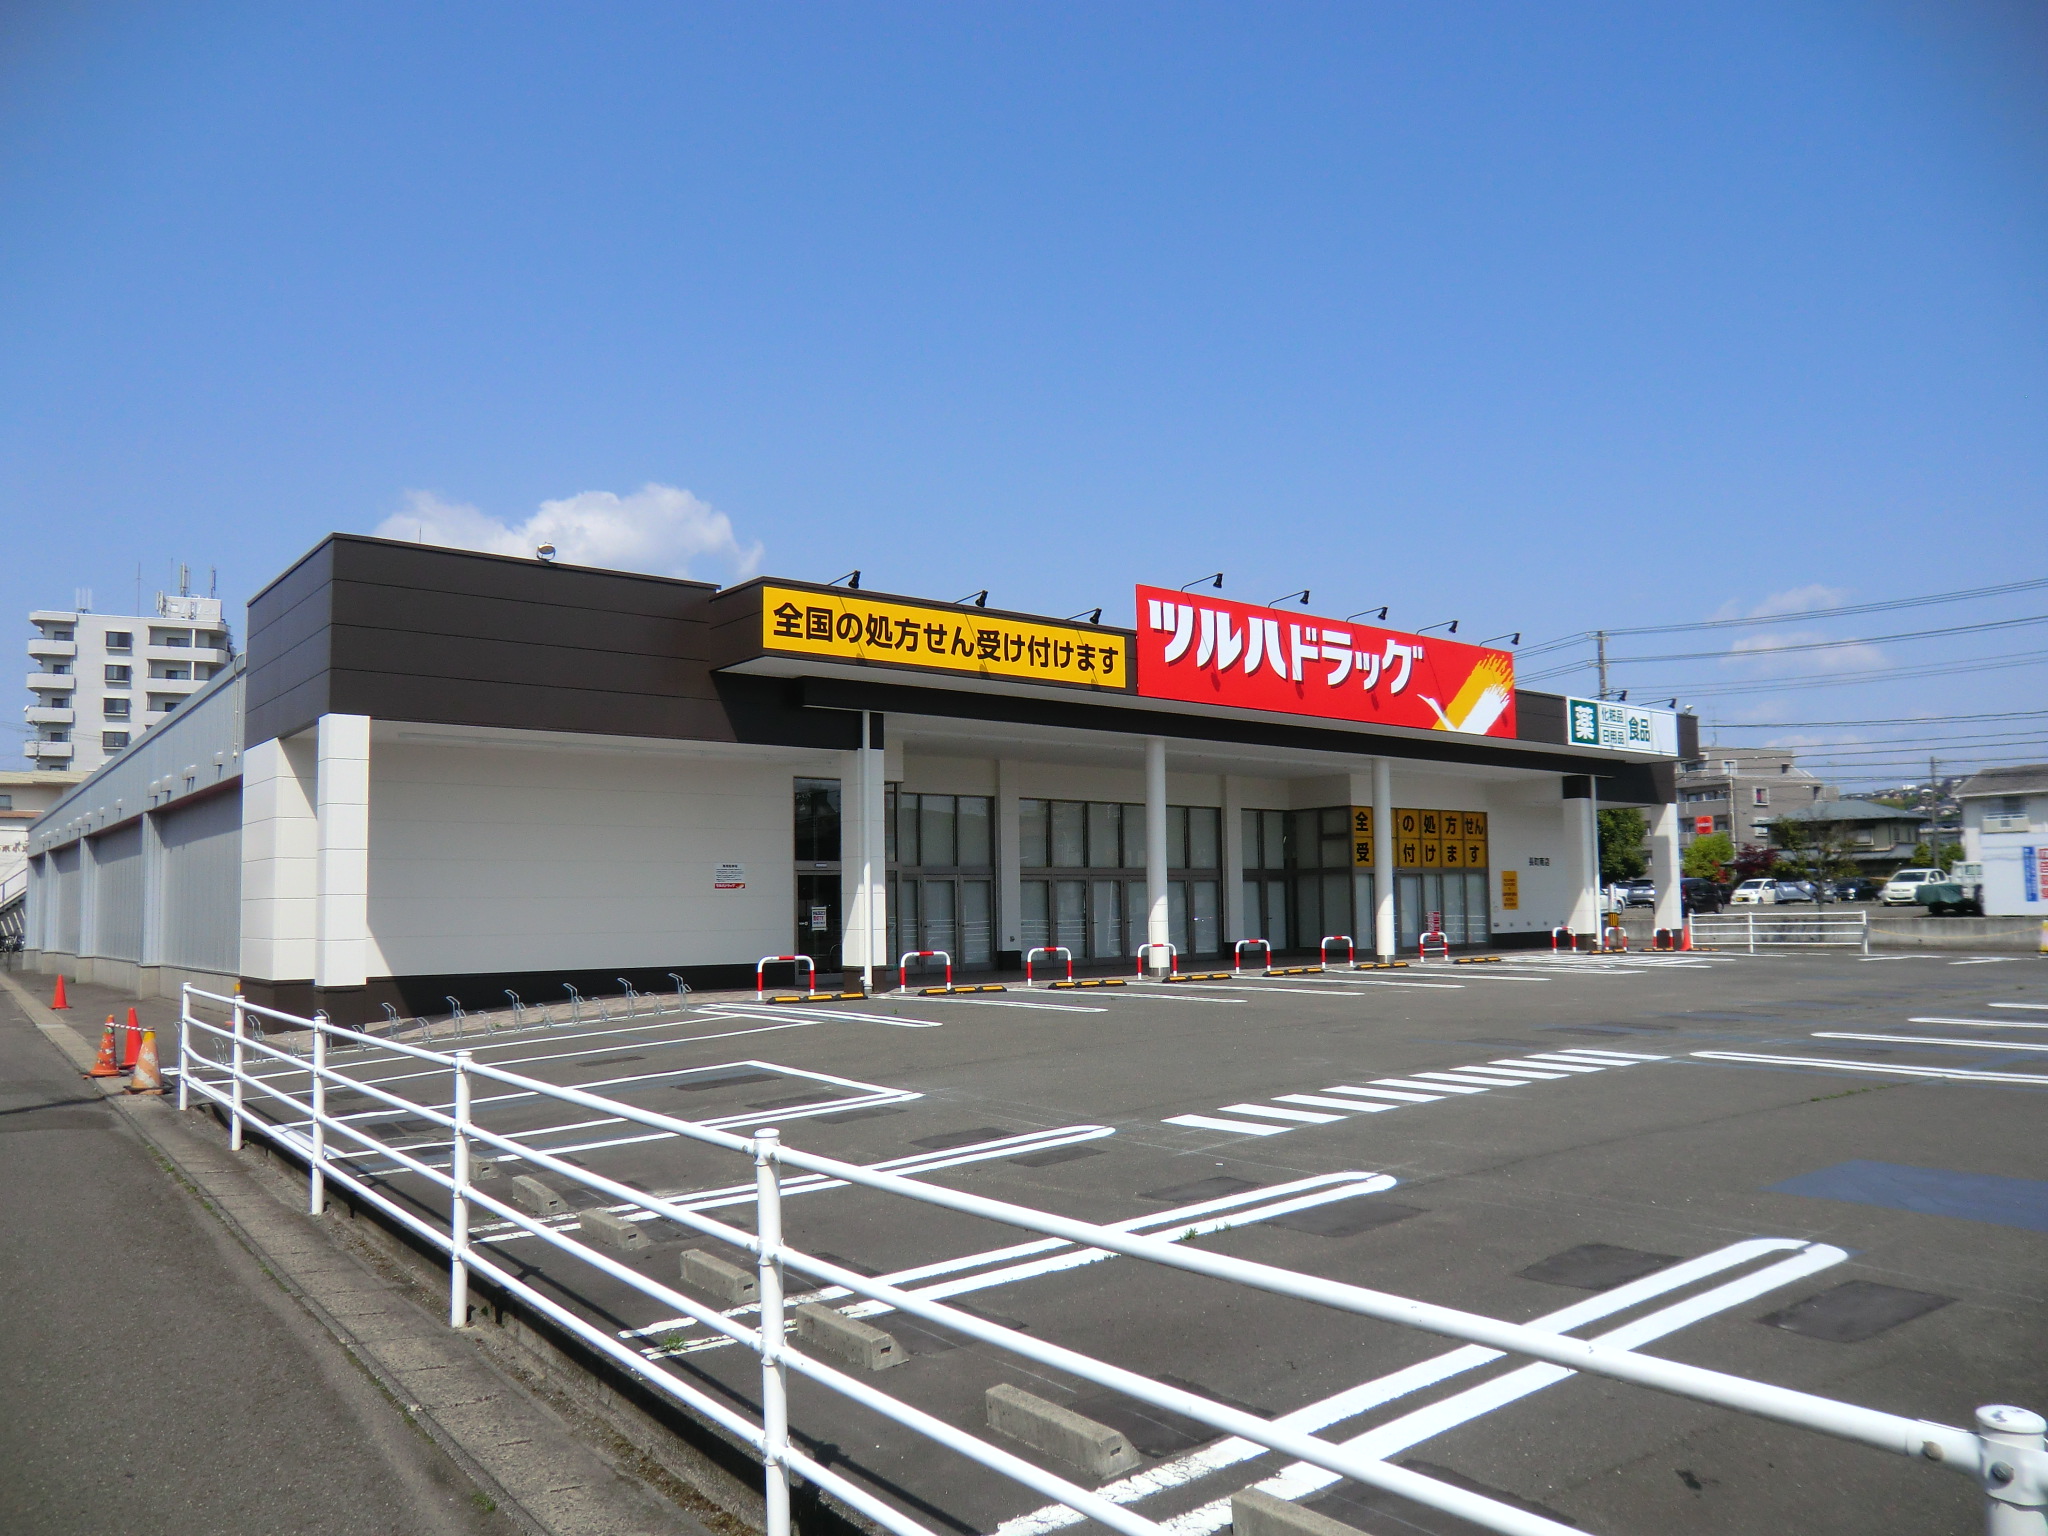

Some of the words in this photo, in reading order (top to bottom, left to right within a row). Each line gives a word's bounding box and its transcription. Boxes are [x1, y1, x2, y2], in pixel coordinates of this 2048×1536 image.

[773, 602, 1119, 675] 全国の処方せん受け付けます
[1148, 599, 1424, 696] ツルハドラッグ
[1574, 705, 1595, 740] 薬
[1601, 707, 1624, 723] 化粧品
[1628, 716, 1651, 742] 食品
[1602, 729, 1625, 745] 日用品
